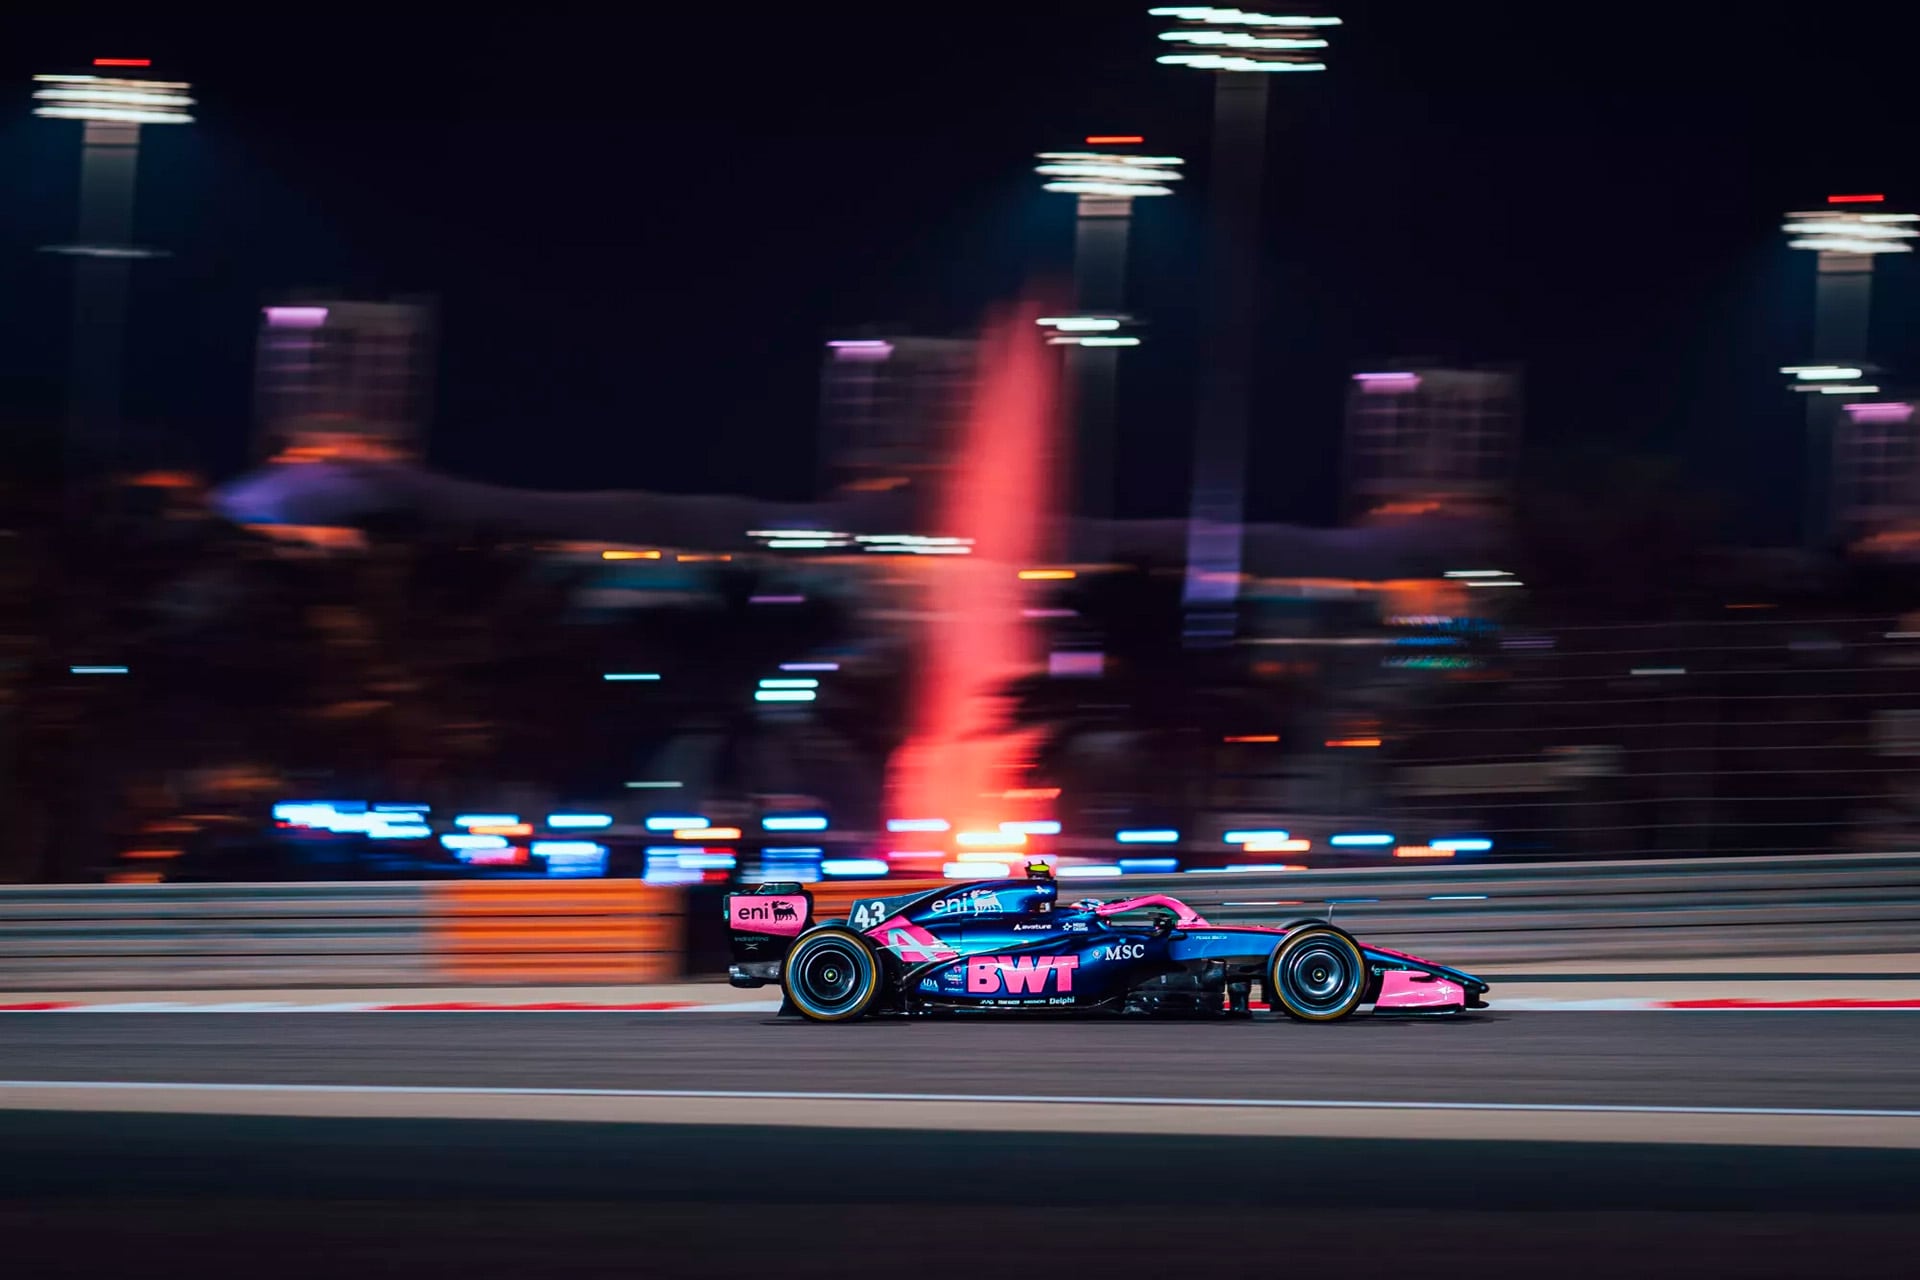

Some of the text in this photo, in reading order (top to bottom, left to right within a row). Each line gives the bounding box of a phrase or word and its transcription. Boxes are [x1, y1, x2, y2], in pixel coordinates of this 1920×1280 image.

[738, 903, 769, 920] eni
[931, 893, 967, 913] eni
[854, 901, 886, 928] 43
[1105, 944, 1145, 960] MSC
[967, 955, 1079, 994] BWT
[1049, 996, 1075, 1005] Delphi
